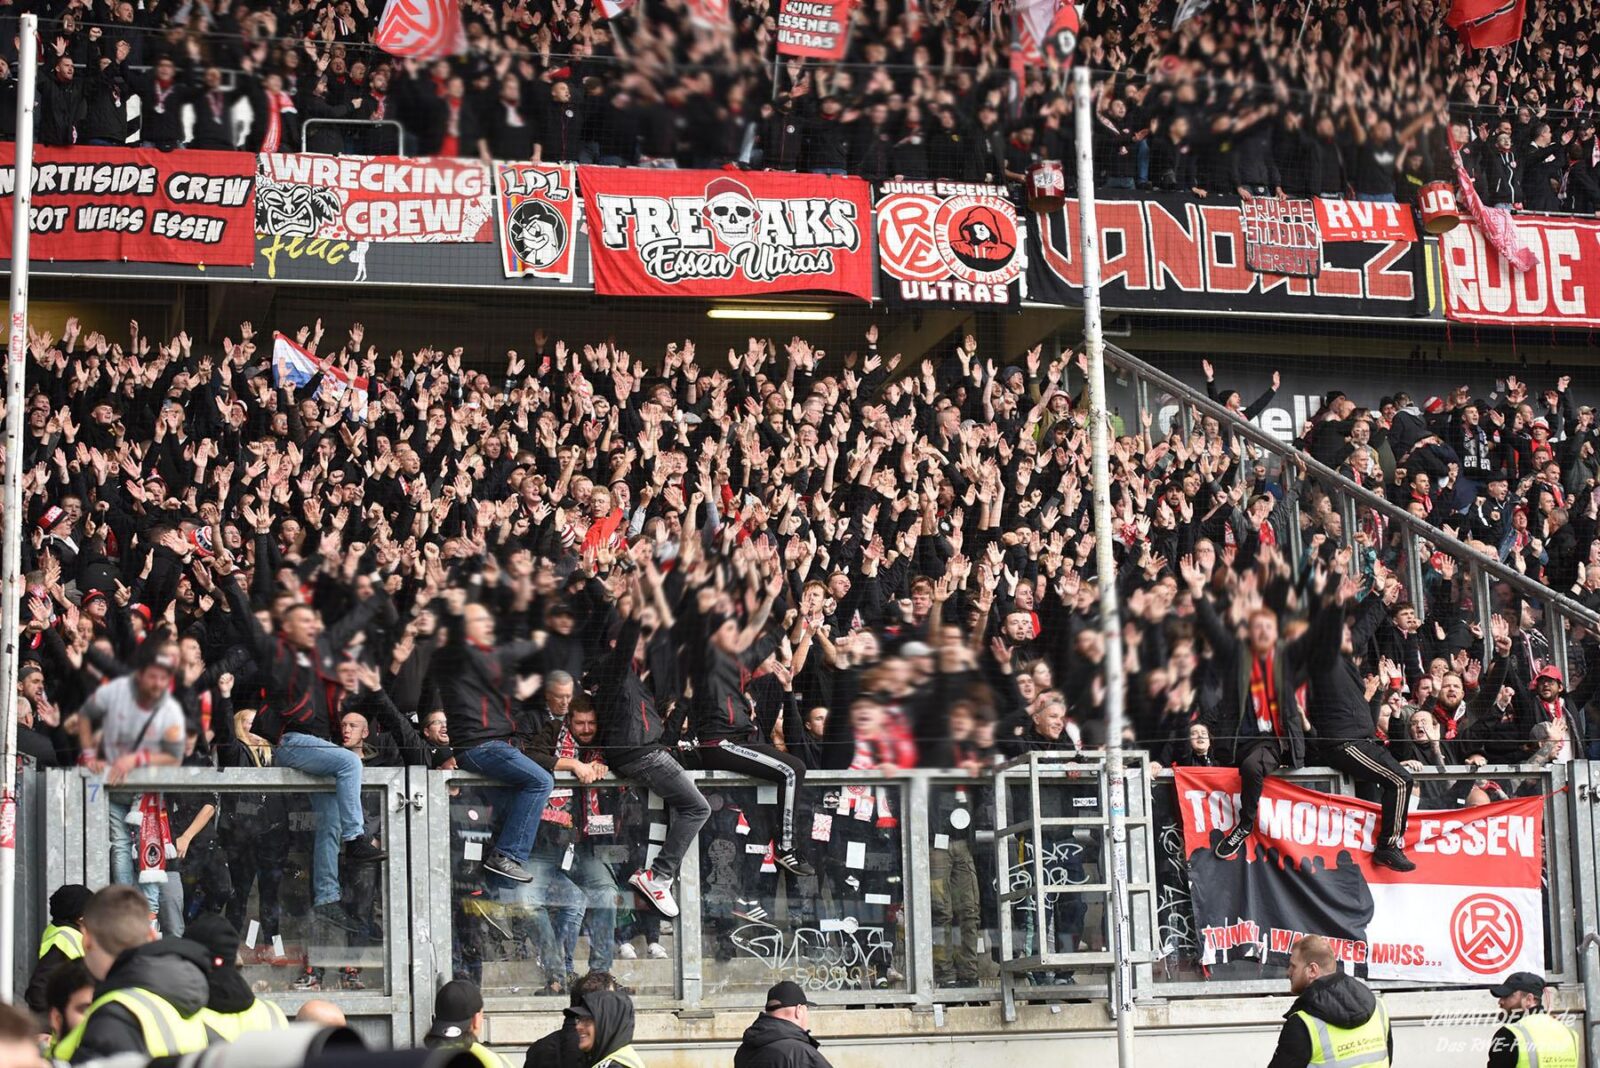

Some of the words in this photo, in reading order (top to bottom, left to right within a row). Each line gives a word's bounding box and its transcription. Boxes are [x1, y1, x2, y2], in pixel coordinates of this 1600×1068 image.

[778, 13, 840, 33] ESSENER
[785, 2, 832, 17] JUNGE
[778, 30, 834, 49] ULTRAS
[169, 175, 250, 206] CREW
[271, 156, 483, 196] WRECKING
[502, 169, 569, 200] LPL
[880, 183, 934, 194] JUNGE
[936, 183, 1009, 196] ESSENER
[29, 206, 69, 231] ROT
[78, 206, 143, 231] WEISS
[153, 214, 226, 242] ESSEN
[345, 198, 462, 236] CREW
[598, 192, 860, 251] FREAKS
[1242, 197, 1315, 223] GRUPPE
[1322, 200, 1400, 229] RVT
[1036, 197, 1415, 300] VANDLZ
[1246, 219, 1320, 248] STADION
[1350, 230, 1388, 239] 0221
[641, 238, 733, 283] Essen
[731, 241, 835, 281] Ultras
[1443, 222, 1586, 315] RUDE
[901, 281, 1009, 303] ULTRAS
[1258, 796, 1405, 854] MODEL
[1414, 815, 1535, 857] ESSEN
[1456, 900, 1517, 967] RWE
